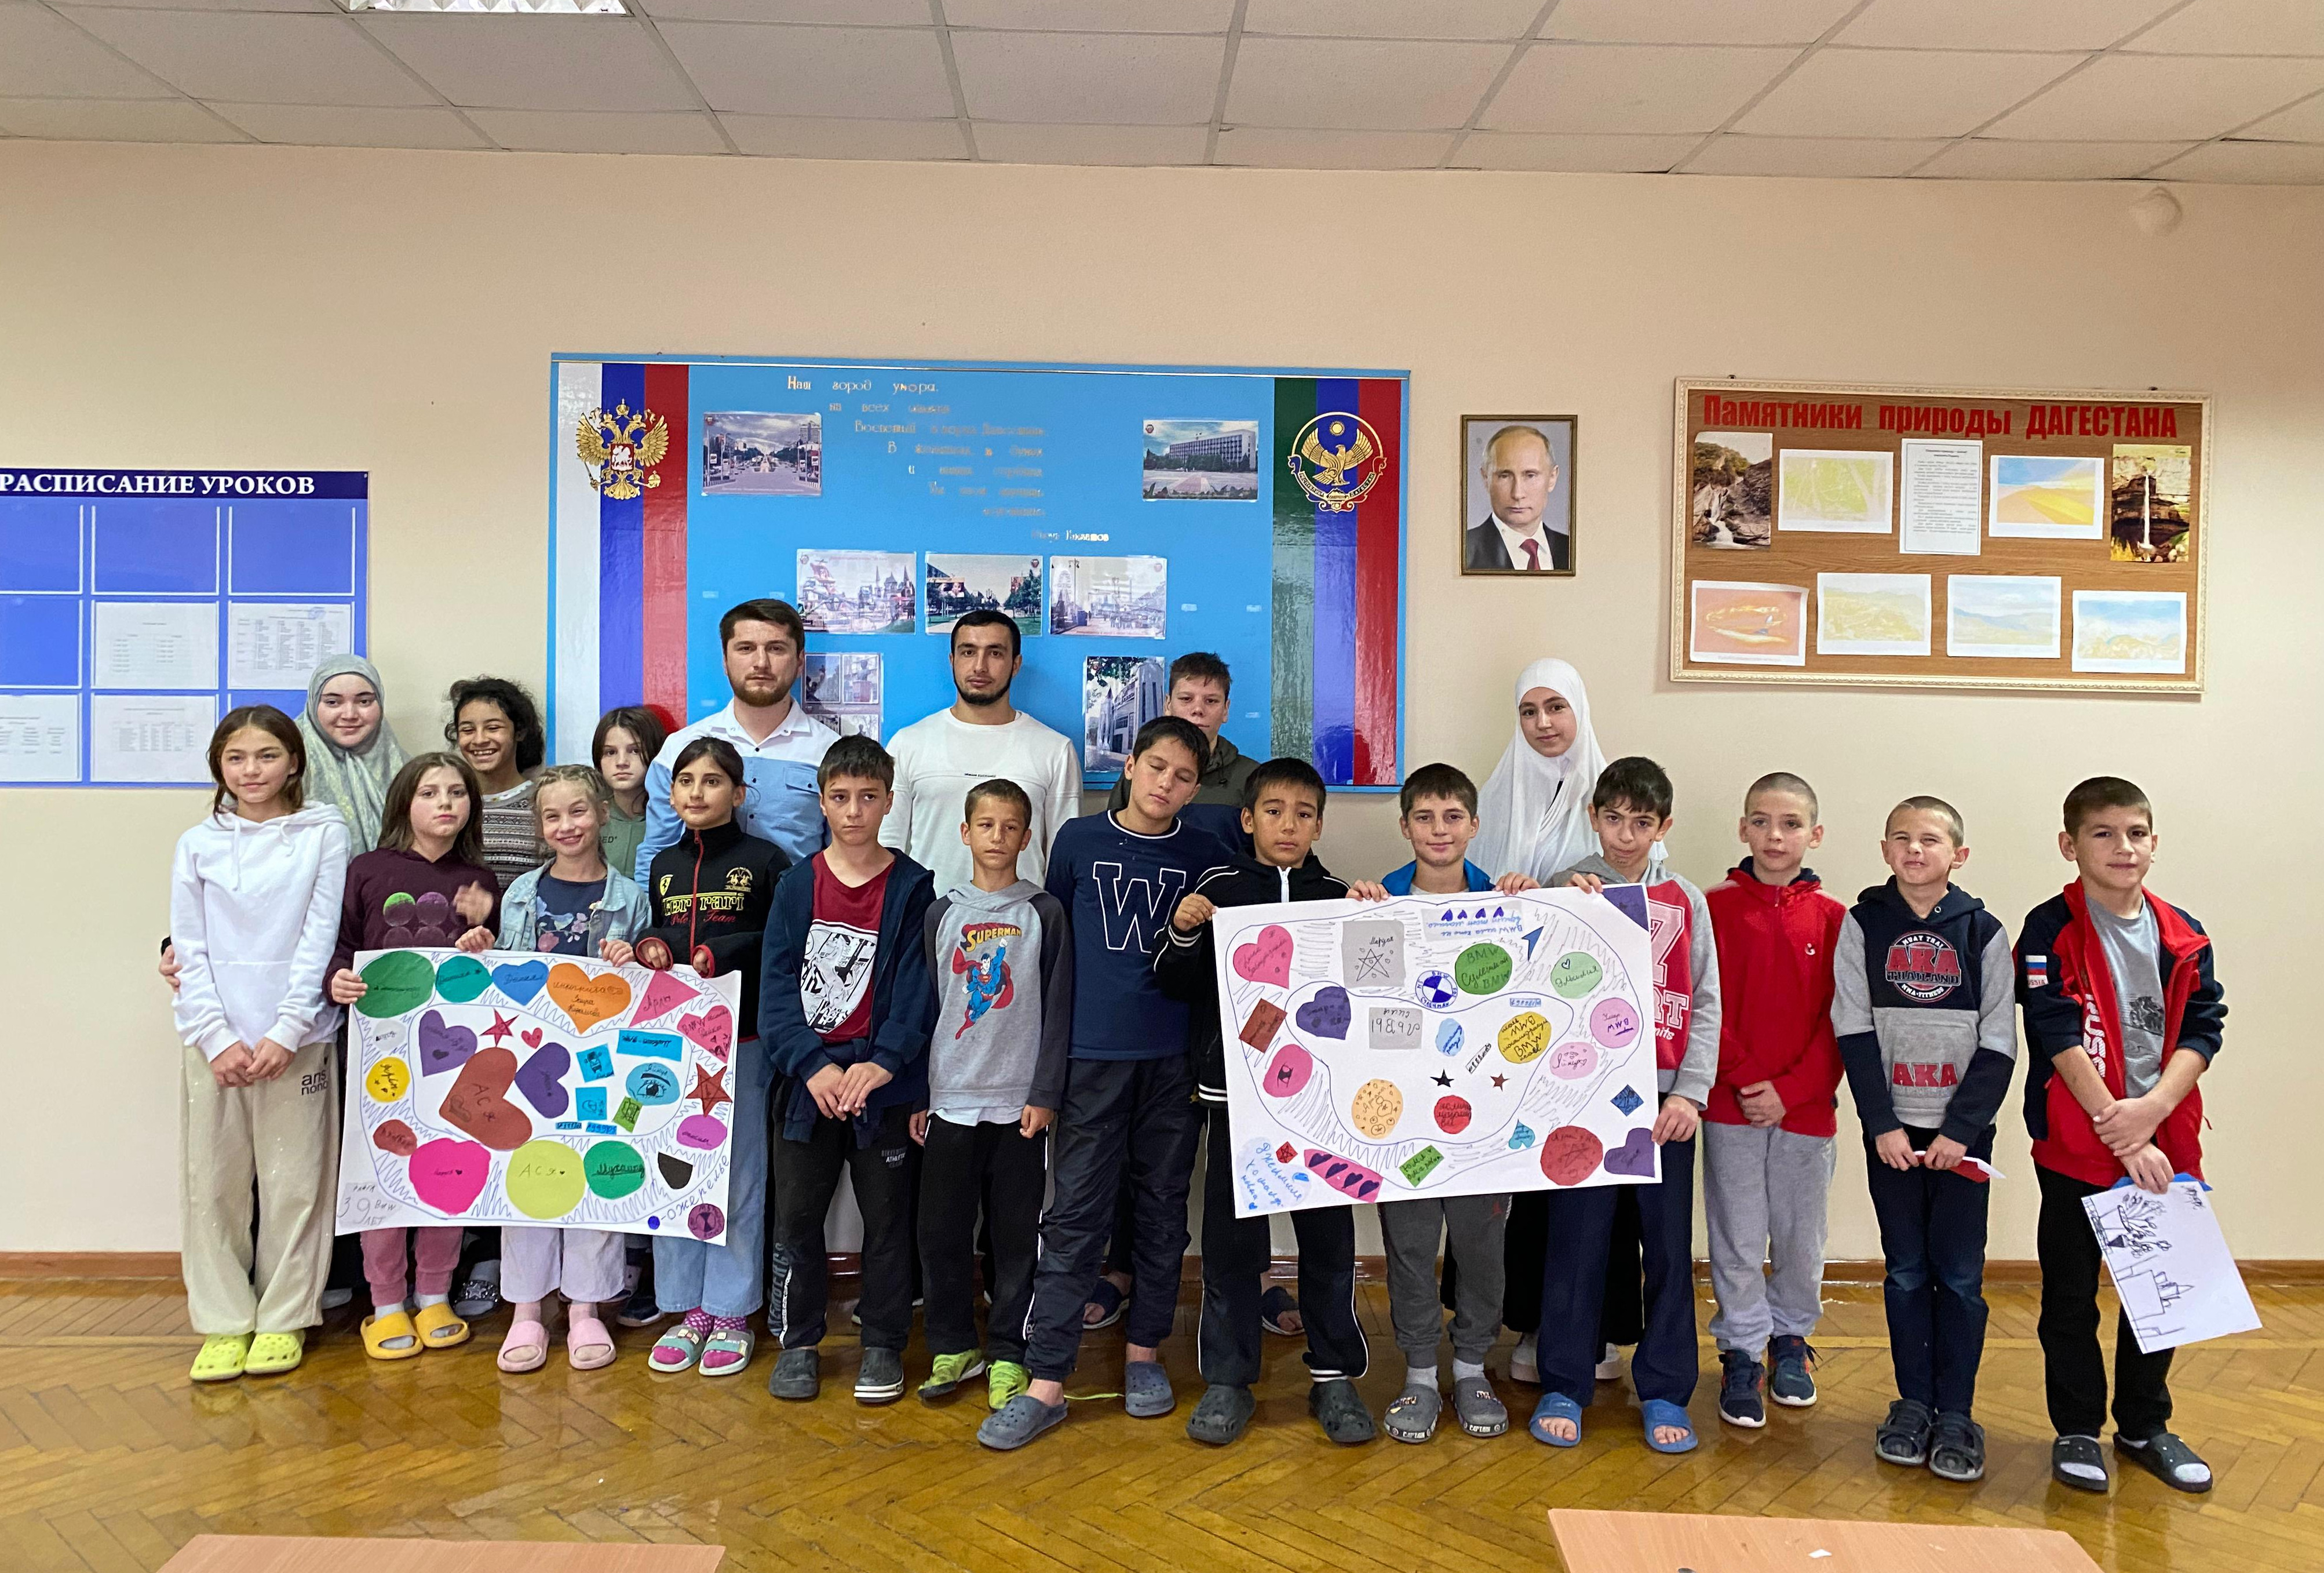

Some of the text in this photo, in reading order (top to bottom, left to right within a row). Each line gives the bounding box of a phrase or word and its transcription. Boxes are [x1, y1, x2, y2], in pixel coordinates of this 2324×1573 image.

[787, 376, 811, 390] Наш
[832, 380, 872, 394] город
[1703, 395, 2178, 440] Памятники природы ДАГЕСТАНА
[0, 473, 315, 495] РАСПИСАНИЕ УРОКОВ
[1093, 861, 1187, 953] W
[965, 927, 1023, 952] SUPERMAN
[1902, 935, 1924, 945] MUAY
[1468, 946, 1500, 963] BMW
[1887, 946, 1961, 975] AKA
[1483, 970, 1511, 989] BMW
[1887, 970, 1960, 985] THAILAND
[1511, 1014, 1537, 1036] BMW
[1607, 1018, 1630, 1033] BMW
[1513, 1034, 1541, 1057] BMW
[301, 1069, 326, 1086] ans
[1892, 1062, 1959, 1087] AKA
